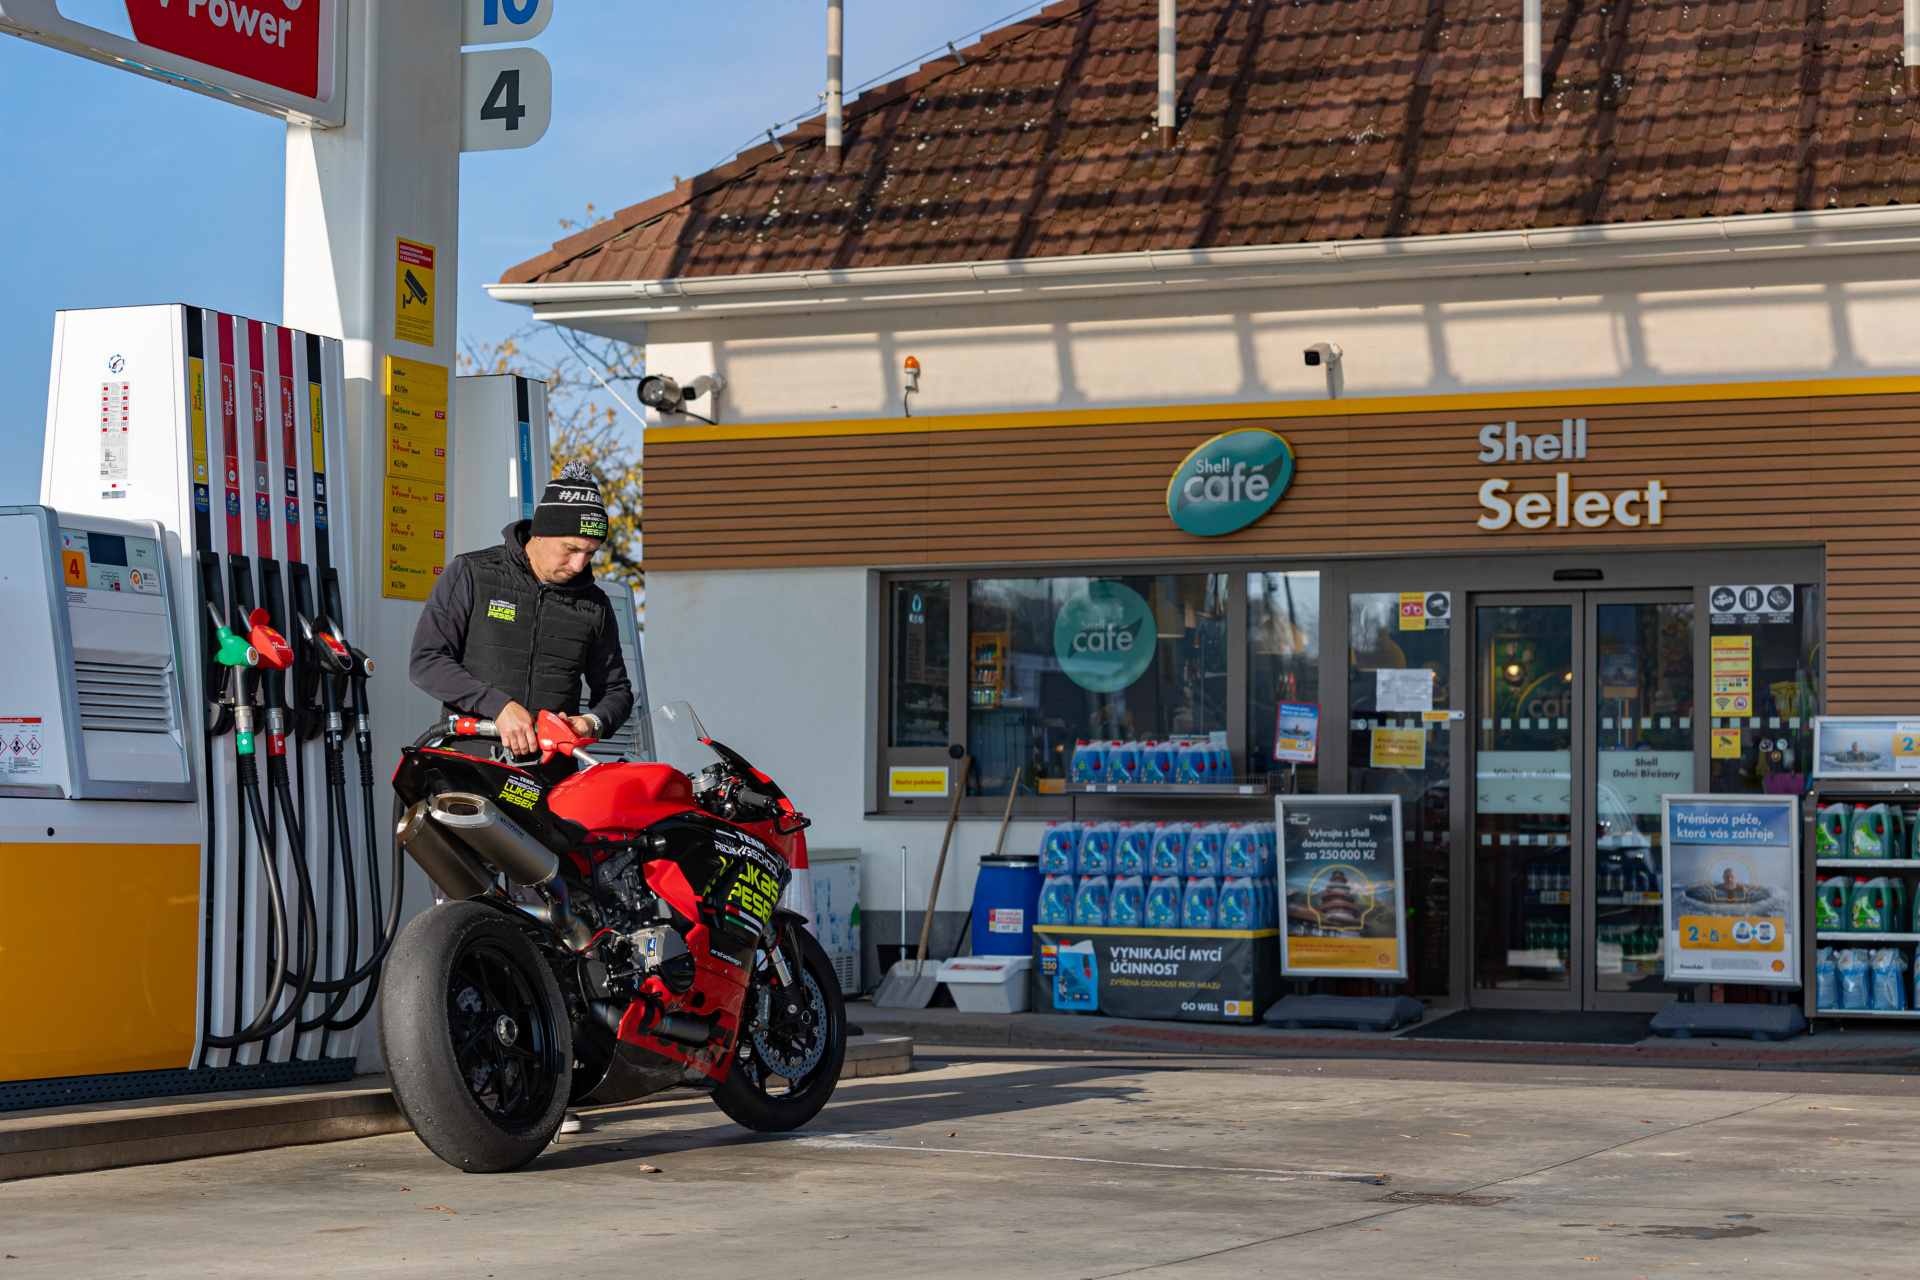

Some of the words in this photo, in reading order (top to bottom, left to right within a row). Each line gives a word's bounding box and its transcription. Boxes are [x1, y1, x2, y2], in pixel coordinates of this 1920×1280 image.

[480, 69, 526, 131] 4
[1477, 418, 1587, 463] Shell
[1195, 457, 1230, 473] Shell
[1184, 462, 1269, 503] café
[1477, 471, 1668, 531] Select
[70, 558, 80, 579] 4
[1073, 623, 1134, 653] café
[1903, 737, 1913, 751] 2
[1635, 757, 1658, 767] Shell
[1613, 768, 1638, 779] Dolní
[1677, 812, 1729, 825] Prémiová
[1731, 812, 1761, 828] péče,
[1308, 828, 1343, 840] Vyhrajte
[1351, 828, 1370, 838] Shell
[1677, 827, 1706, 839] která
[1711, 828, 1729, 839] vás
[1731, 827, 1775, 841] zahřeje
[1302, 839, 1344, 848] dovolenou
[1345, 839, 1357, 848] od
[1304, 851, 1318, 860] za
[1363, 849, 1376, 860] Kč
[1688, 926, 1699, 942] 2
[1110, 945, 1187, 962] VYNIKAJÍCÍ
[1190, 946, 1223, 963] MYCÍ
[1110, 960, 1180, 976] ÚČINNOST
[1181, 1002, 1196, 1011] GO
[1198, 1002, 1219, 1012] WELL
